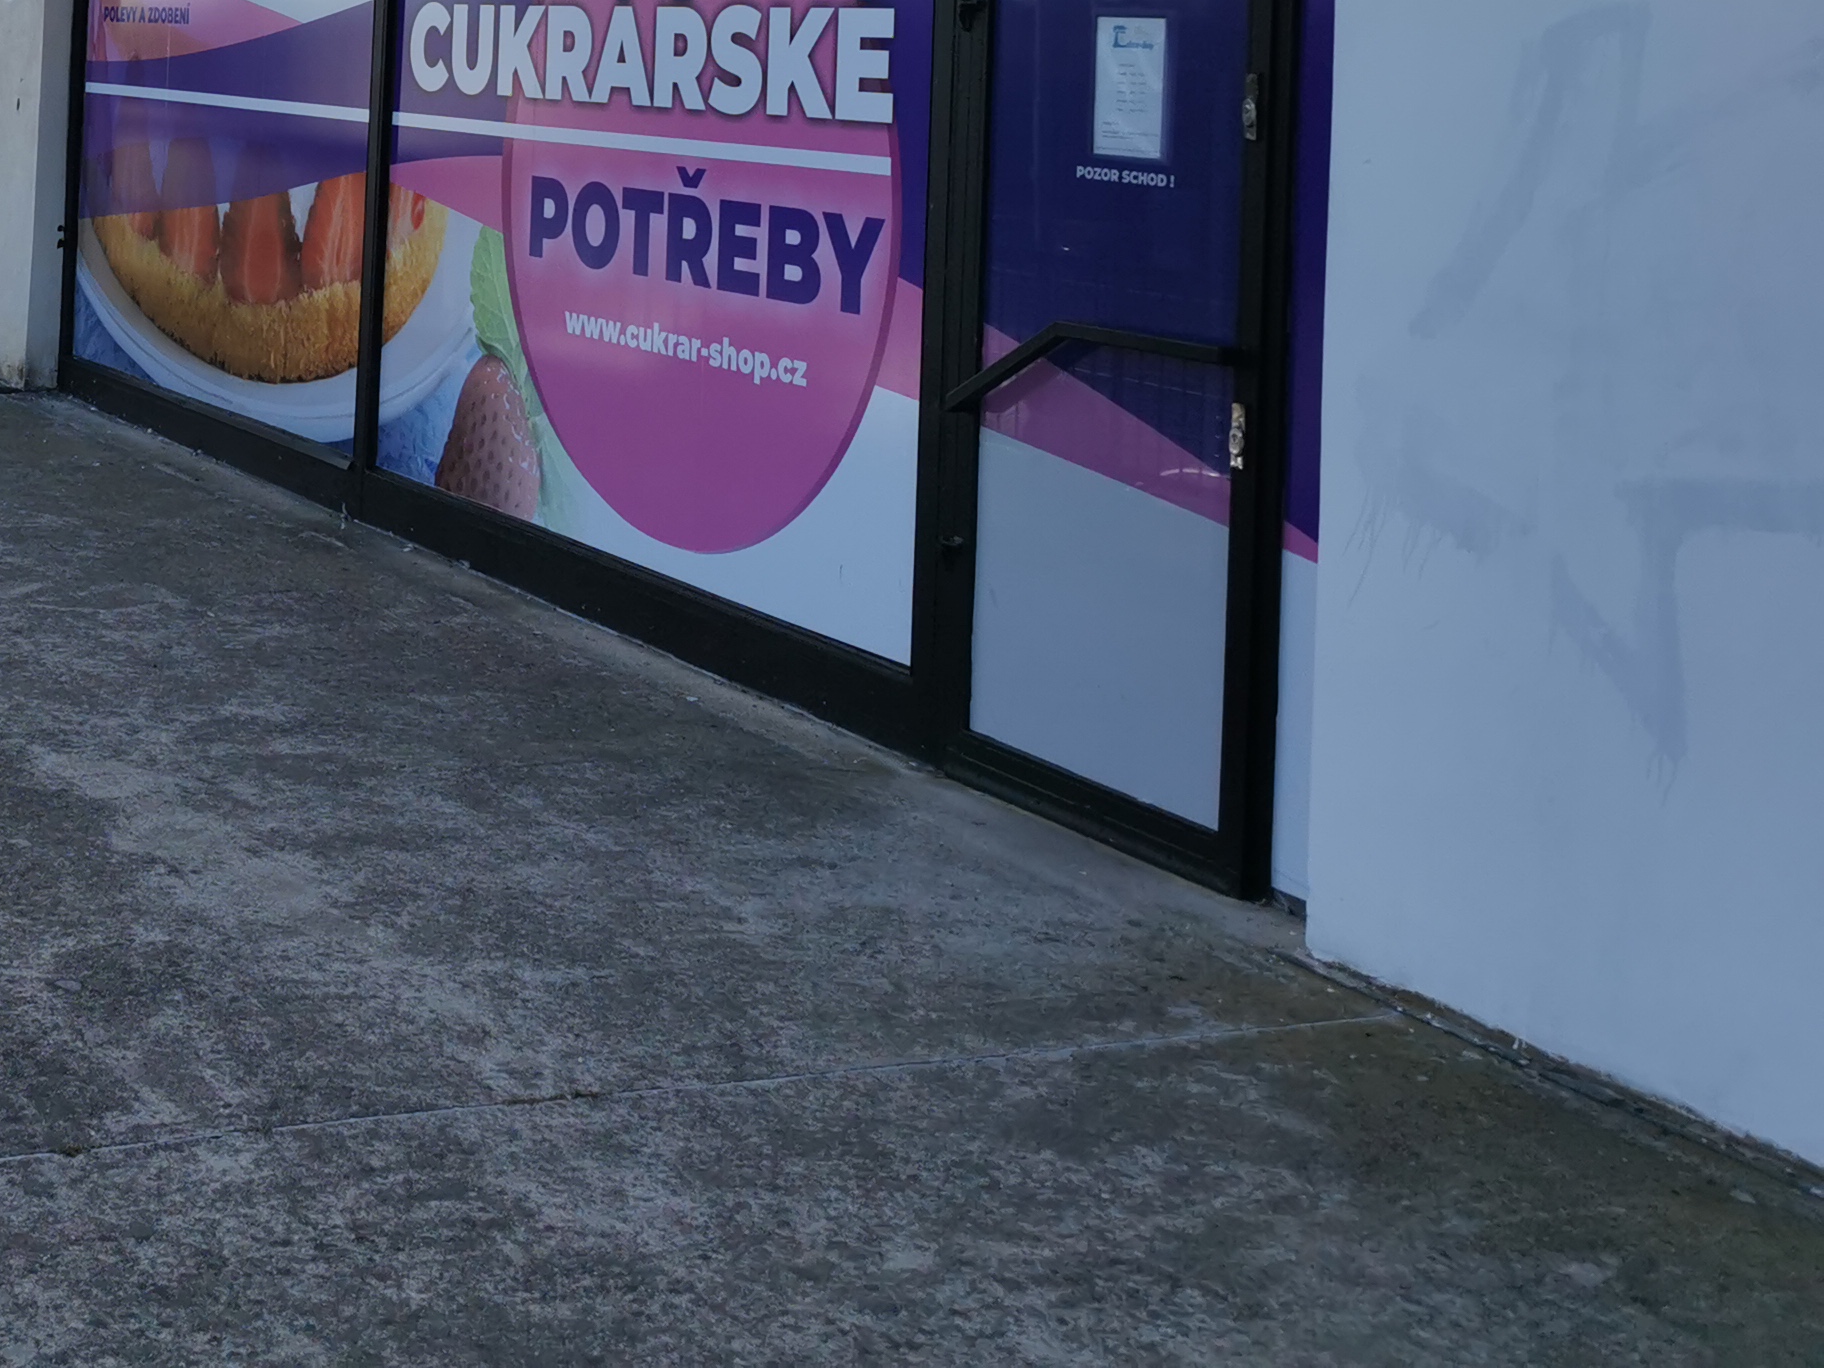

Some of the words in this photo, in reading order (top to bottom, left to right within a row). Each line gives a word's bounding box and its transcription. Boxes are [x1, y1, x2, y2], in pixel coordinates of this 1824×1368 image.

[104, 6, 137, 23] POLEVY
[139, 7, 146, 23] A
[148, 2, 191, 24] ZDOBENÍ
[1076, 165, 1119, 182] POZOR
[1121, 170, 1167, 187] SCHOD
[528, 167, 885, 315] POTŘEBY
[564, 307, 807, 387] www.cukrar-shop.cz
